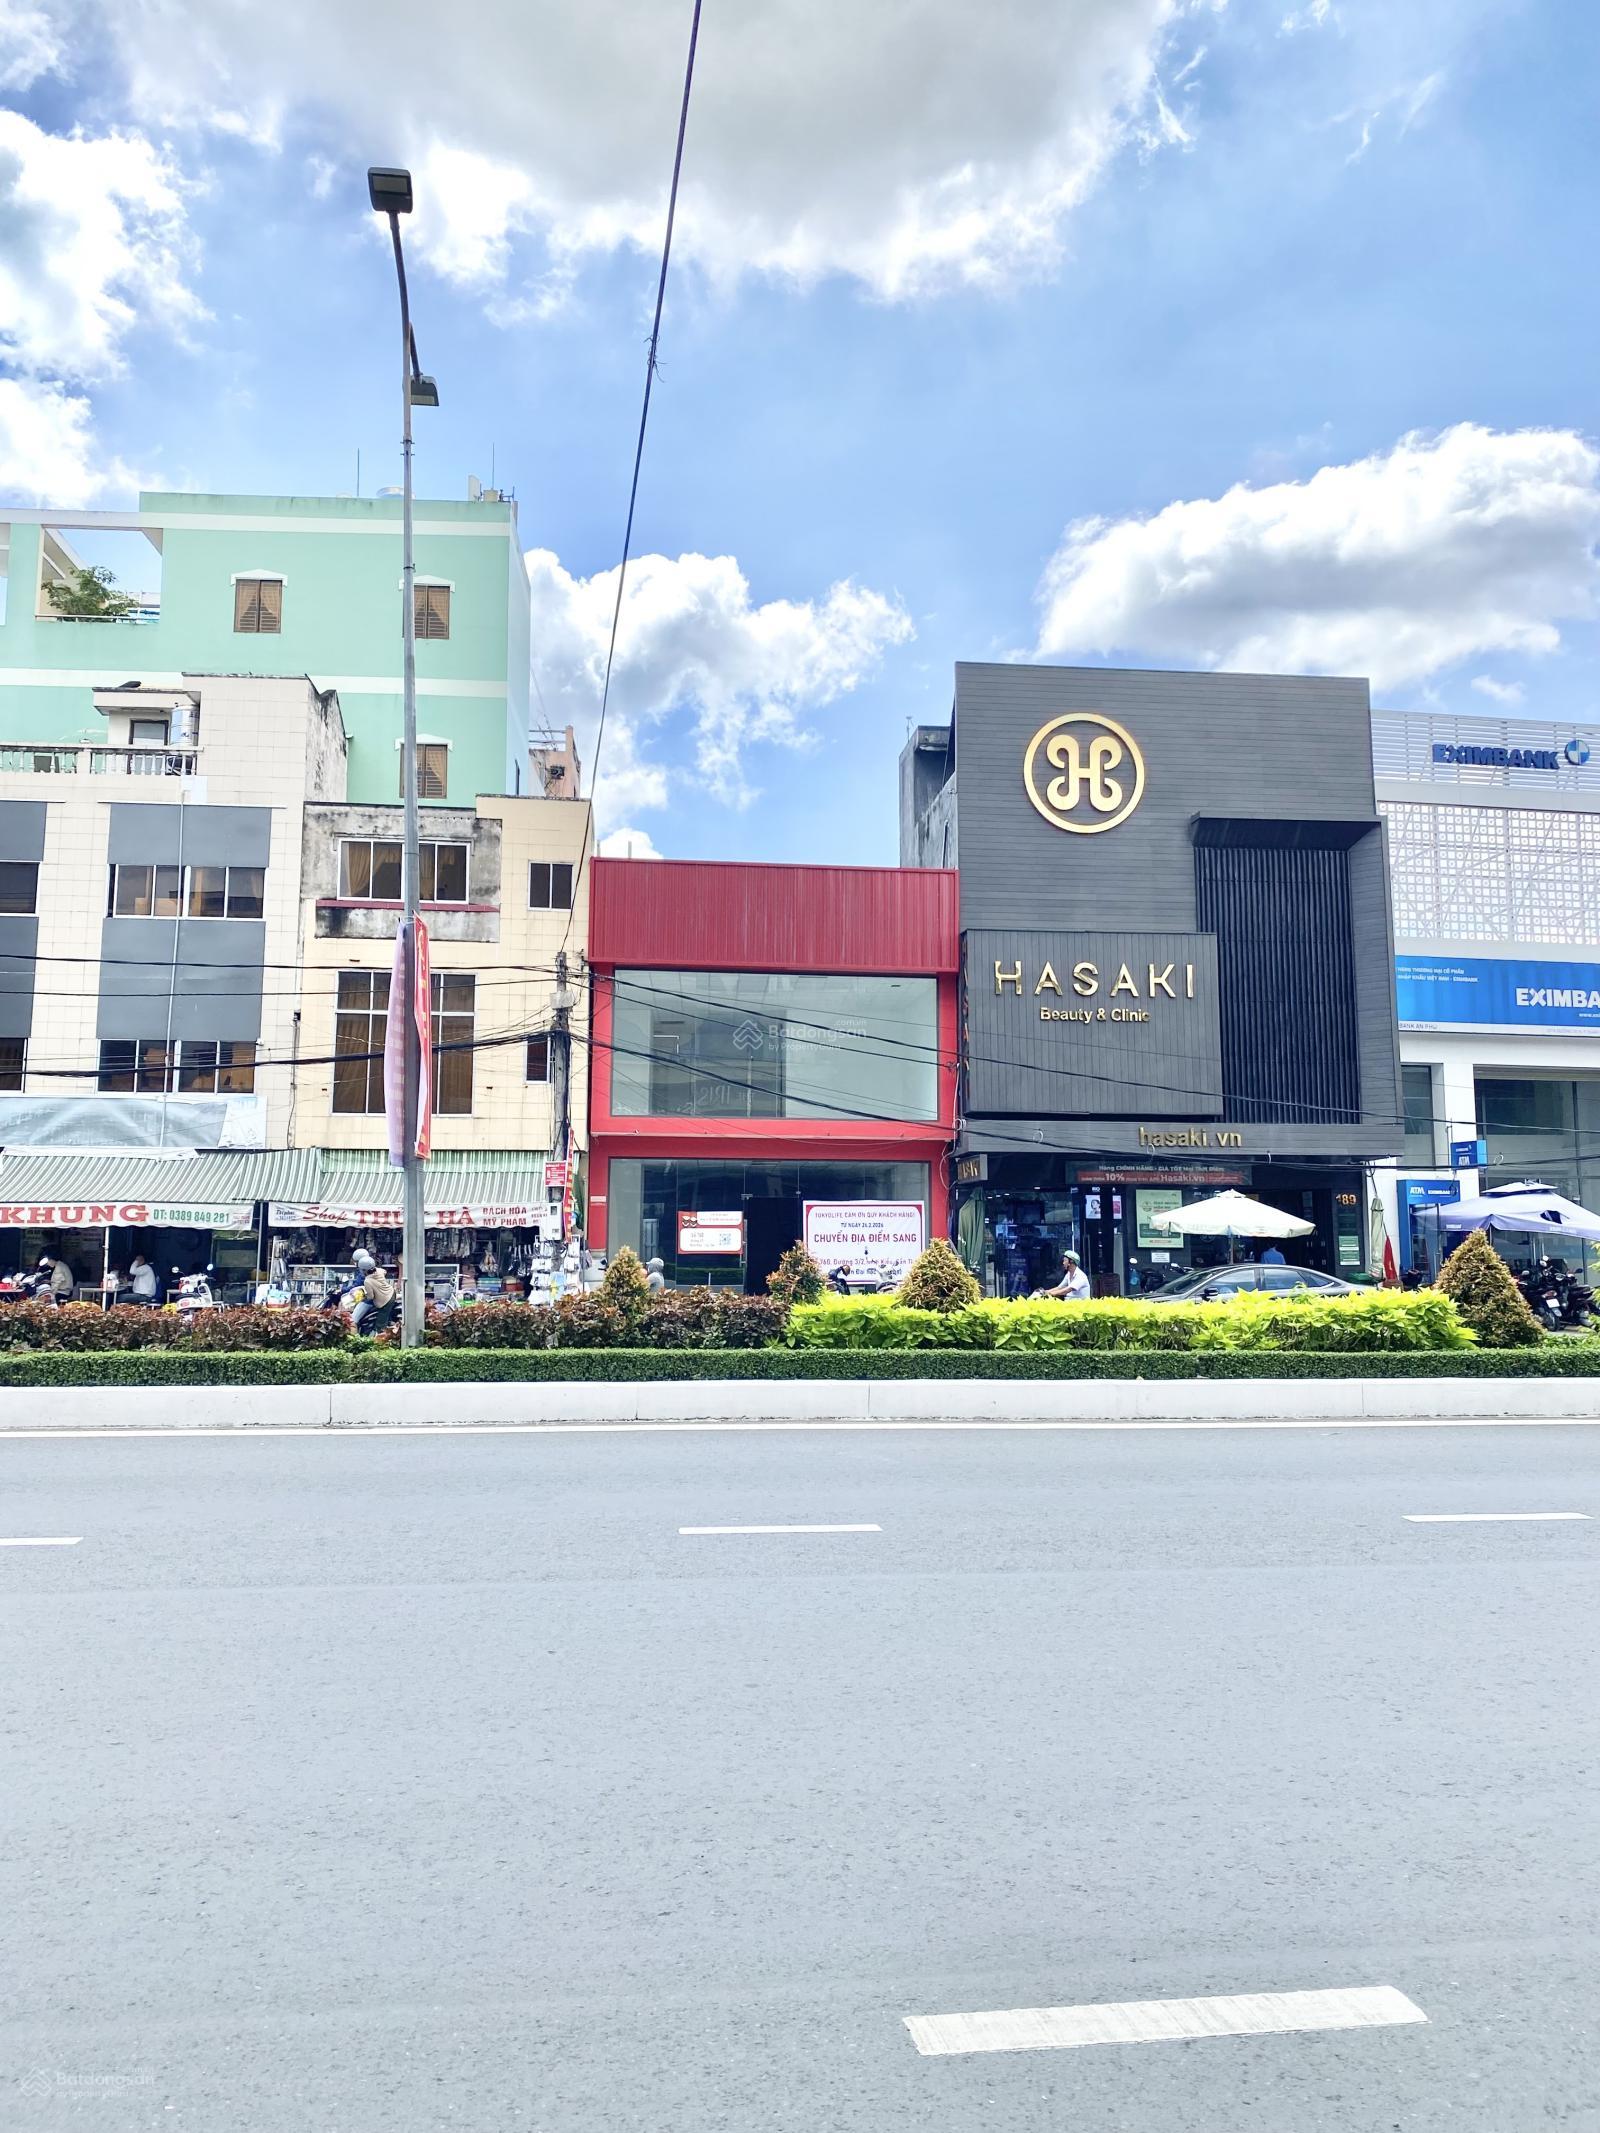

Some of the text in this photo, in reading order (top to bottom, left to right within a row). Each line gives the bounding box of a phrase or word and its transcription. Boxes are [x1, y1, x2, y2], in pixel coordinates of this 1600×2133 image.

[1432, 744, 1561, 771] EXIMBANK
[994, 960, 1194, 998] HASAKI
[1040, 1007, 1151, 1023] Beauty & Clinic
[1139, 1126, 1243, 1147] hasaki.vn
[1335, 1193, 1357, 1206] 189
[0, 1204, 149, 1223] KHUNG
[170, 1210, 192, 1221] 0389
[194, 1211, 210, 1222] 849
[303, 1206, 348, 1224] Shop
[436, 1205, 475, 1226] HÀ
[893, 1233, 917, 1242] SANG
